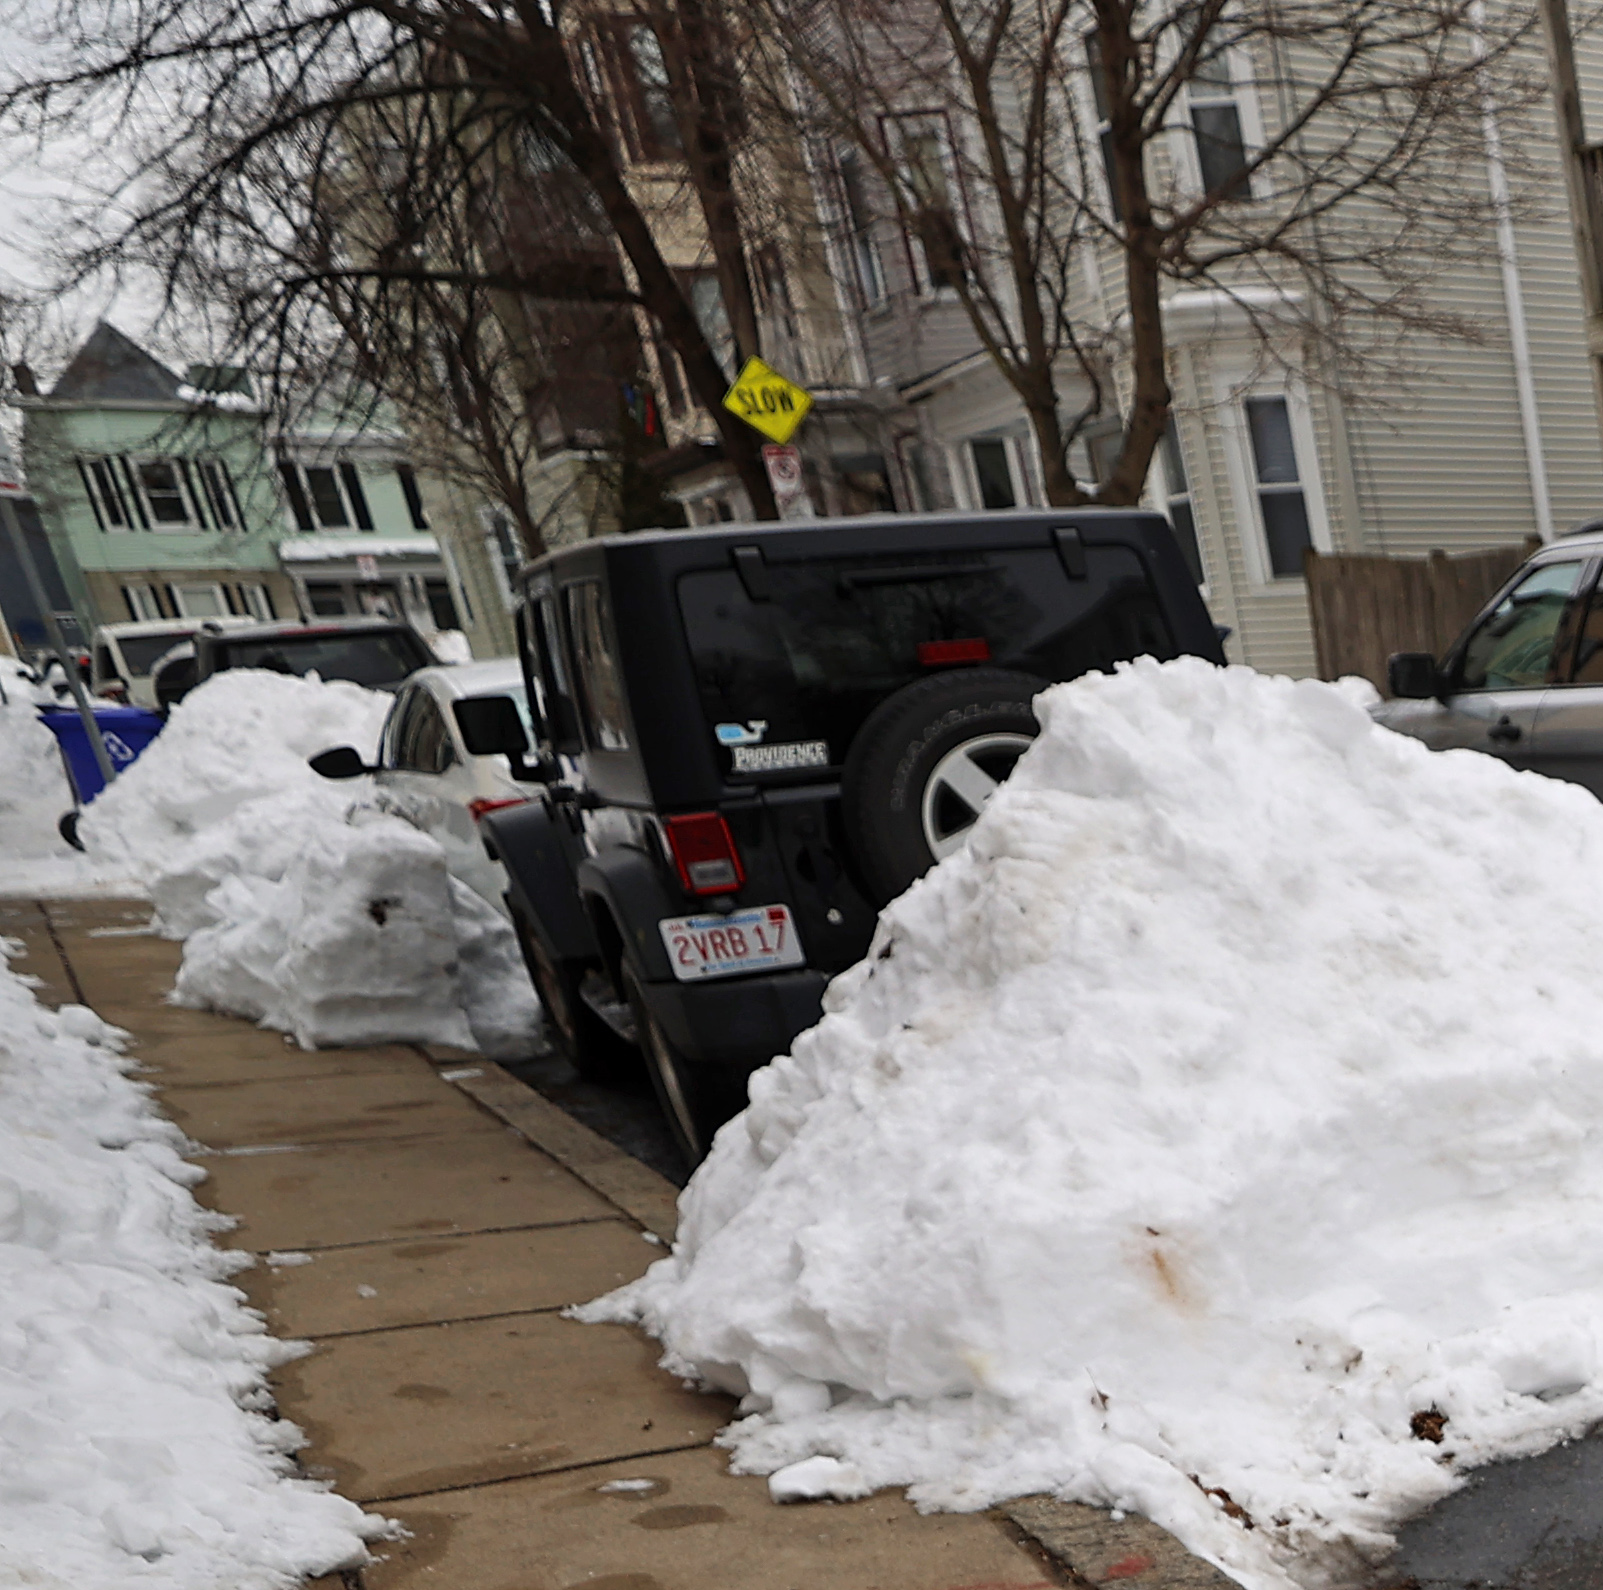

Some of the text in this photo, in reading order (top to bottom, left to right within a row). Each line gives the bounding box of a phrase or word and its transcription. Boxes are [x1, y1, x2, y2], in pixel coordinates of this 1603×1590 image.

[736, 386, 795, 415] SLOW
[733, 740, 828, 772] PROVIDENCE
[672, 920, 785, 968] 2VRB 17
